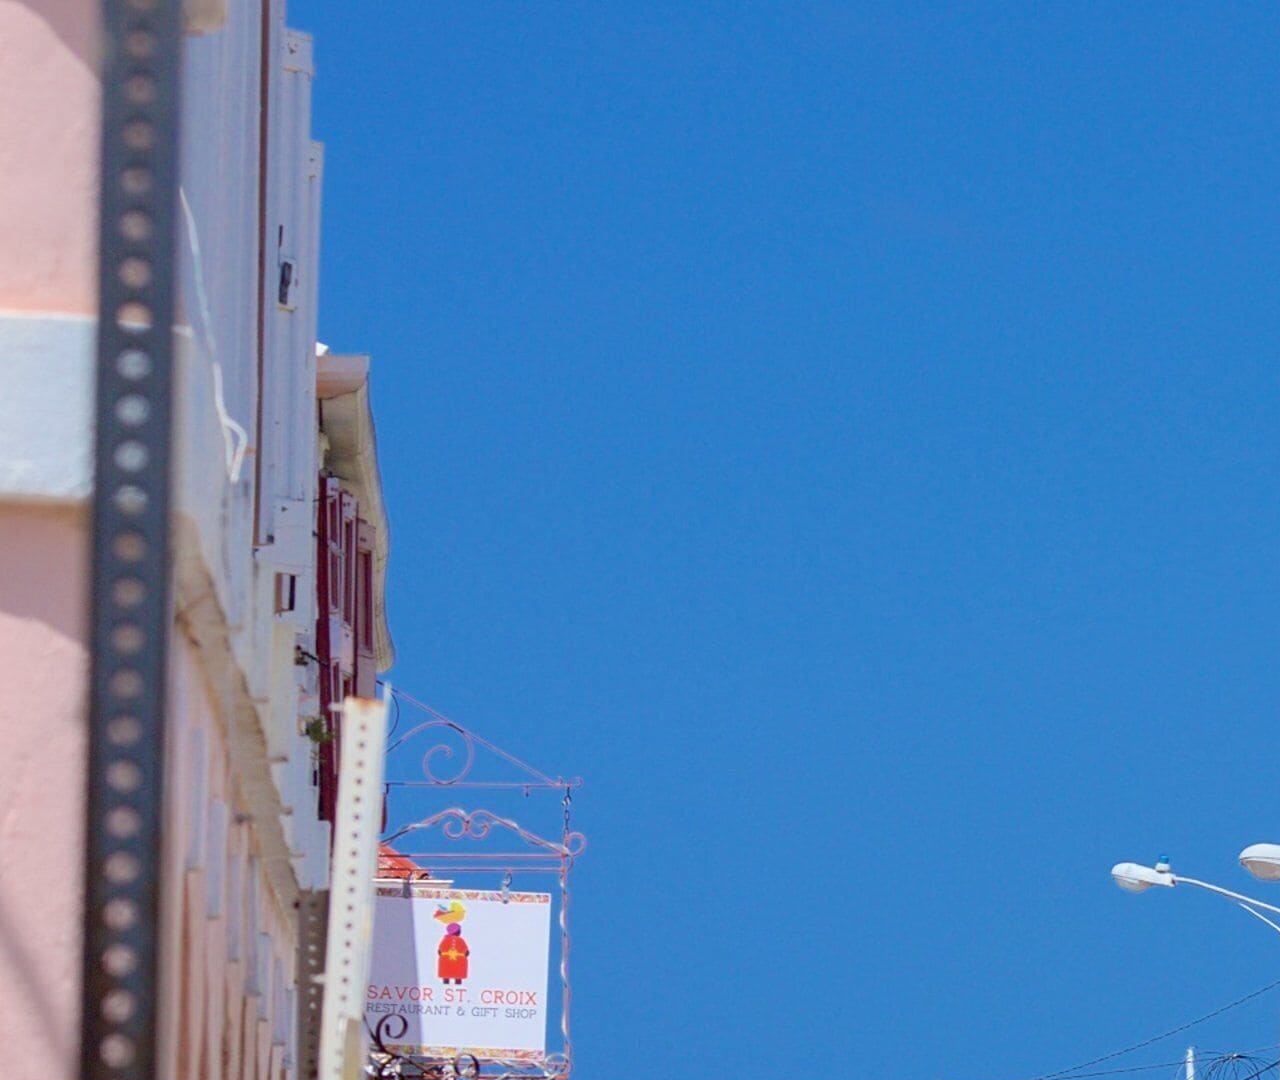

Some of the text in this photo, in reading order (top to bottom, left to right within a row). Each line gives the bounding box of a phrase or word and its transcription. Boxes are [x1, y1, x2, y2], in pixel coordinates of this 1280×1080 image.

[366, 985, 538, 1005] SAVOR ST. CROIX
[366, 1002, 537, 1019] RESTAURANT & GIFT SHOP
